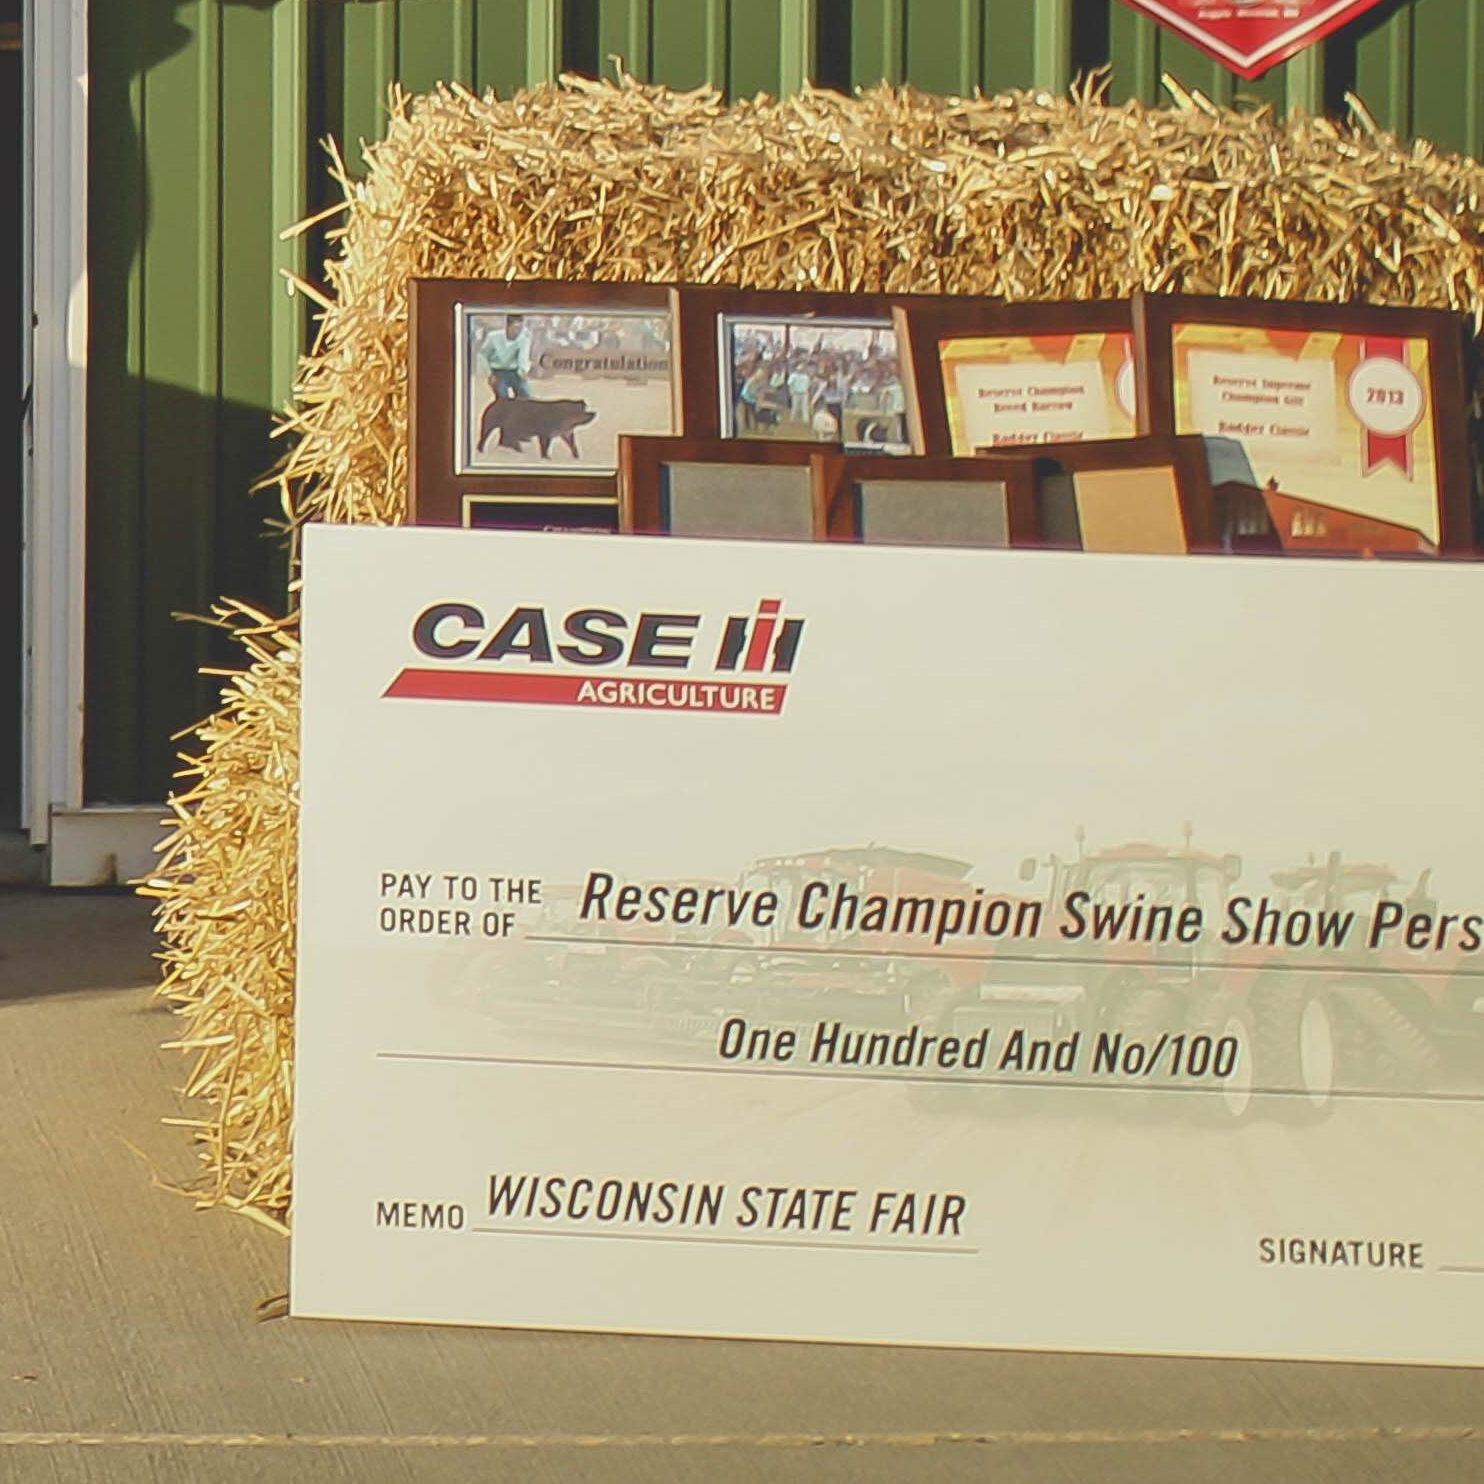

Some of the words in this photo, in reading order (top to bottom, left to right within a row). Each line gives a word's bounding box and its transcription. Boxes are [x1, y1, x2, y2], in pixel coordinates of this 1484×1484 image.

[412, 603, 702, 670] CASE
[577, 680, 776, 712] AGRICULTURE
[380, 872, 431, 900] PAY
[444, 875, 478, 902] TO
[489, 877, 543, 905] THE
[580, 871, 779, 928] Reserve
[798, 881, 1042, 945] Champion
[1059, 890, 1203, 943] Swine
[1221, 896, 1355, 948] Show
[1369, 899, 1484, 953] Pers
[380, 908, 471, 936] ORDER
[482, 912, 516, 938] OF
[718, 1016, 796, 1062] One
[810, 1021, 990, 1069] Hundred
[998, 1028, 1081, 1073] And
[1091, 1031, 1239, 1078] No/100
[376, 1200, 466, 1230] MEMO
[487, 1174, 726, 1227] WISCONSIN
[736, 1186, 858, 1232] STATE
[868, 1190, 966, 1236] FAIR
[1258, 1236, 1425, 1268] SIGNATURE
